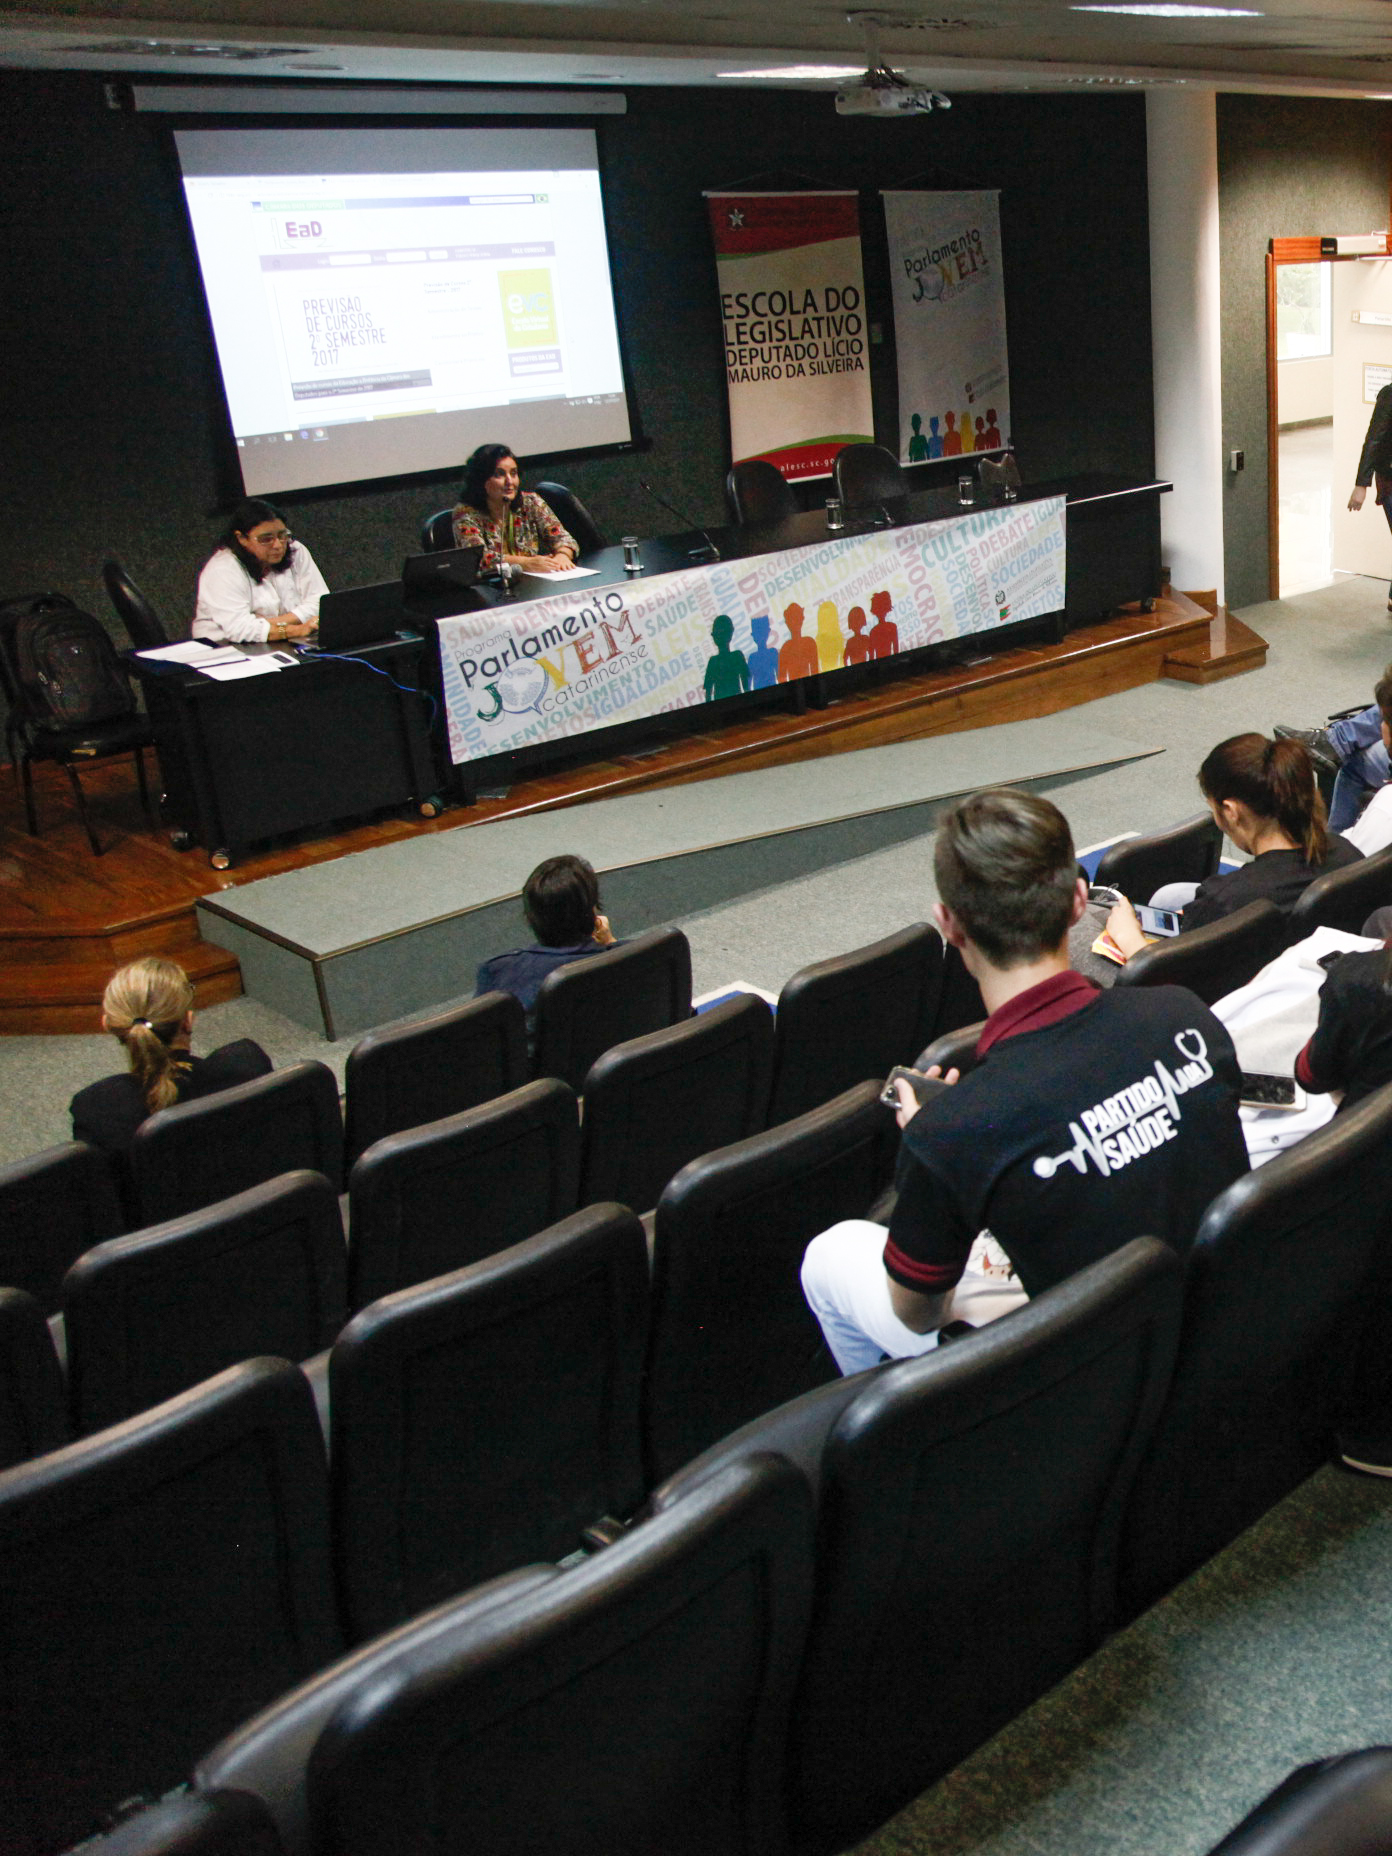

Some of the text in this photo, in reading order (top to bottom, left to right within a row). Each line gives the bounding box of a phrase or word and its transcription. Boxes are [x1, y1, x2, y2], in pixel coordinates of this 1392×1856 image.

[285, 220, 322, 239] EaD
[903, 228, 980, 279] Parlamento
[302, 294, 363, 317] PREVISÃO
[508, 292, 549, 315] evc
[721, 286, 861, 320] ESCOLA DO
[306, 312, 373, 333] DE CURSOS
[325, 328, 388, 349] SEMESTRE
[724, 313, 862, 347] LEGISLATIVO
[312, 349, 339, 367] 2017
[726, 337, 864, 368] DEPUTADO LÍCIO
[728, 356, 865, 384] MAURO DA SILVEIRA
[781, 458, 835, 473] alesc.sc.go
[979, 512, 1034, 560] DEBATE
[987, 537, 1030, 573] CULTURA
[991, 530, 1063, 590] SOCIEDADE
[635, 575, 693, 620] DEBATE
[942, 558, 972, 635] SOCIEDA
[644, 593, 699, 638] SAÚDE
[454, 630, 513, 663] Programa
[458, 592, 624, 690] Parlamento
[476, 609, 644, 726] JOVEM
[542, 644, 650, 713] catarinense
[592, 650, 693, 721] IGUALDADE
[1080, 1075, 1164, 1138] PARTIDO
[1101, 1106, 1178, 1170] SAÚDE
